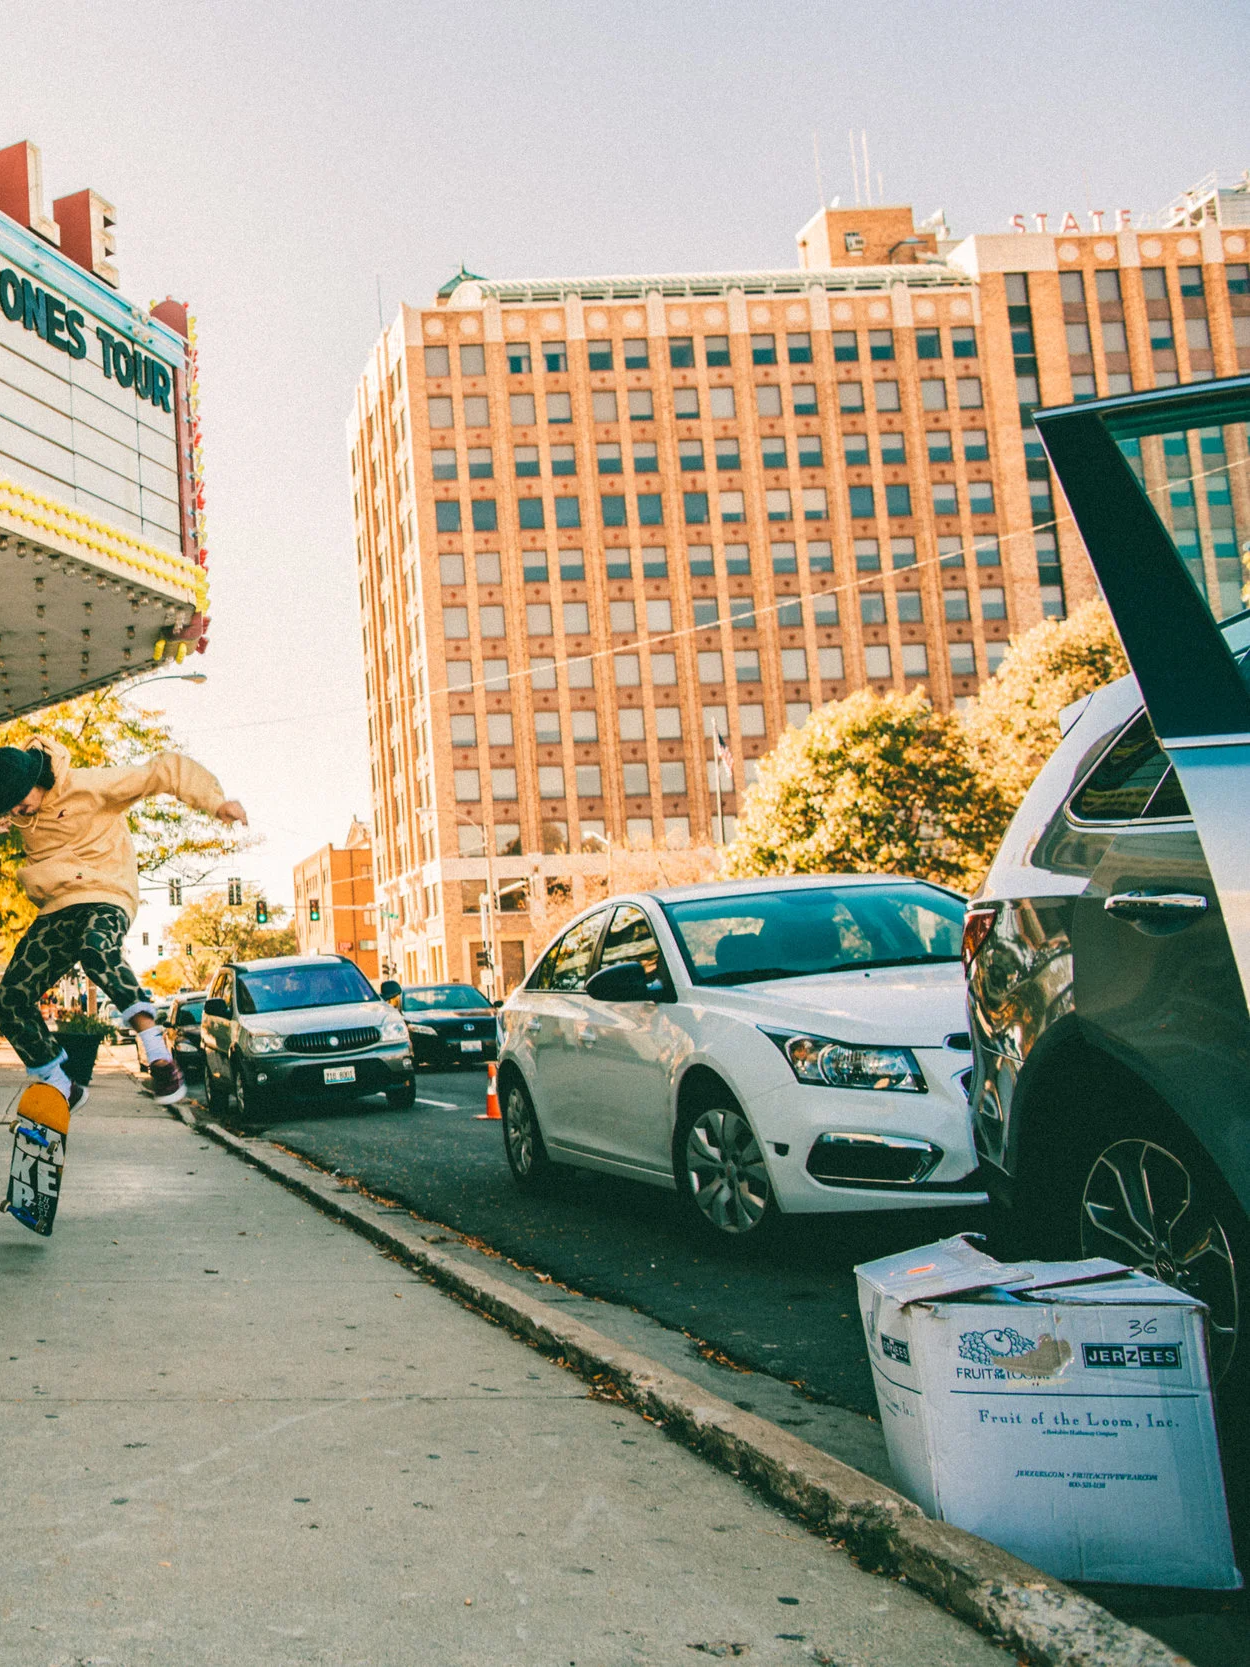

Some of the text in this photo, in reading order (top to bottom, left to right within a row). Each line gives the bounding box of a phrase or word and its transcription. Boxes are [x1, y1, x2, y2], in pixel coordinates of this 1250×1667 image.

[96, 326, 172, 413] TOUR
[1128, 1318, 1158, 1338] 36
[1088, 1350, 1177, 1363] JERZEES
[956, 1367, 993, 1380] FRUIT
[978, 1409, 1179, 1428] Fruit of the Loom, Inc.
